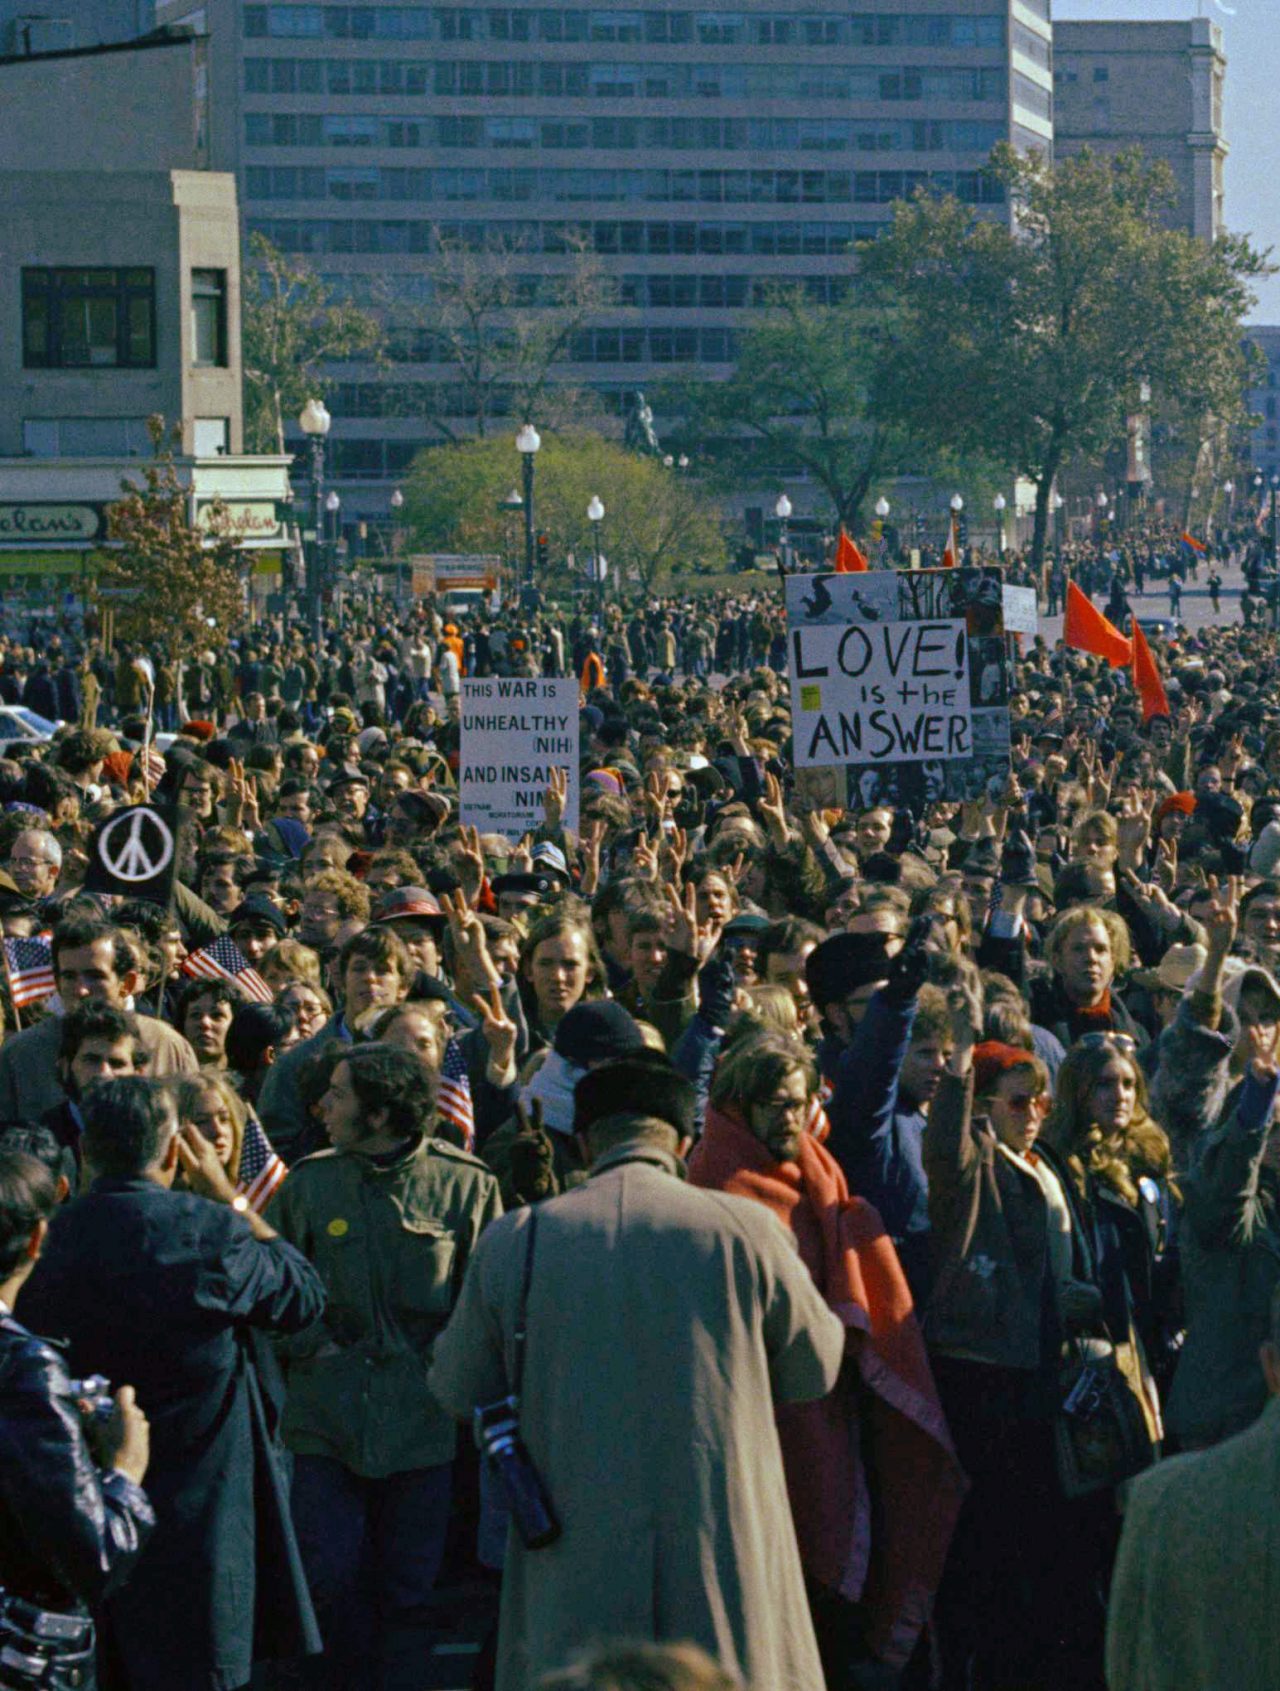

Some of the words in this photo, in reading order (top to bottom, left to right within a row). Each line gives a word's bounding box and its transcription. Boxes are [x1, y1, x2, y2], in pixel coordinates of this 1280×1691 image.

[793, 624, 966, 680] LOVE!
[463, 683, 493, 698] THIS
[498, 681, 538, 698] WAR
[543, 685, 556, 698] IS
[463, 715, 569, 731] UNHEALTHY
[807, 709, 971, 759] ANSWER
[533, 737, 573, 754] (NIH)
[463, 766, 498, 783] AND
